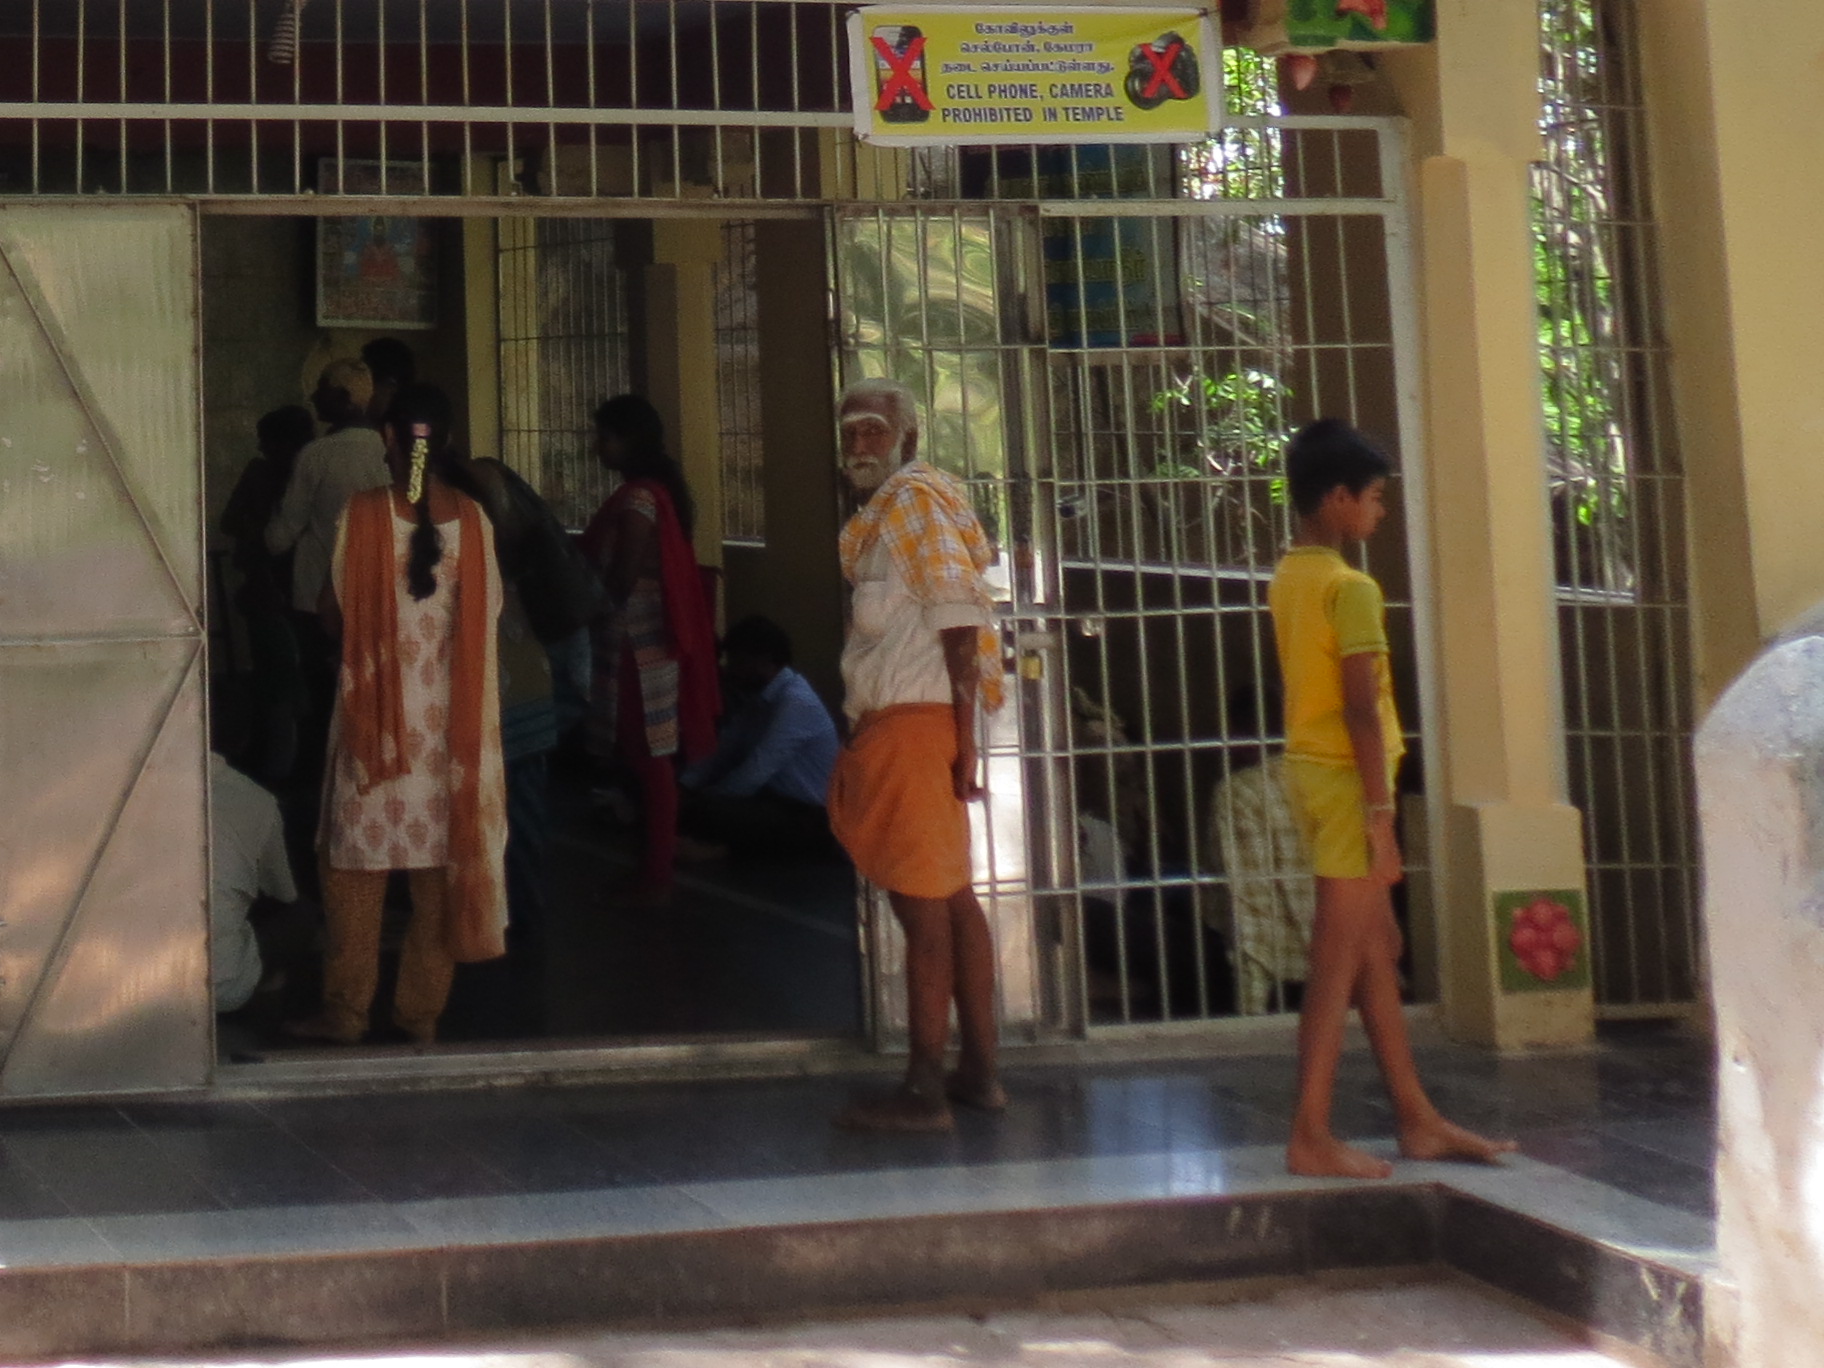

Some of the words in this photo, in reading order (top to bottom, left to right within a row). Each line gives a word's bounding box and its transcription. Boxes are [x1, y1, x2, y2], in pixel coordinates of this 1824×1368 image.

[947, 83, 983, 100] CELL
[988, 84, 1044, 102] PHONE,
[1049, 83, 1113, 99] CAMERA
[942, 107, 1033, 124] PROHIBITED
[1043, 108, 1059, 123] IN
[1063, 106, 1124, 122] TEMPLE
